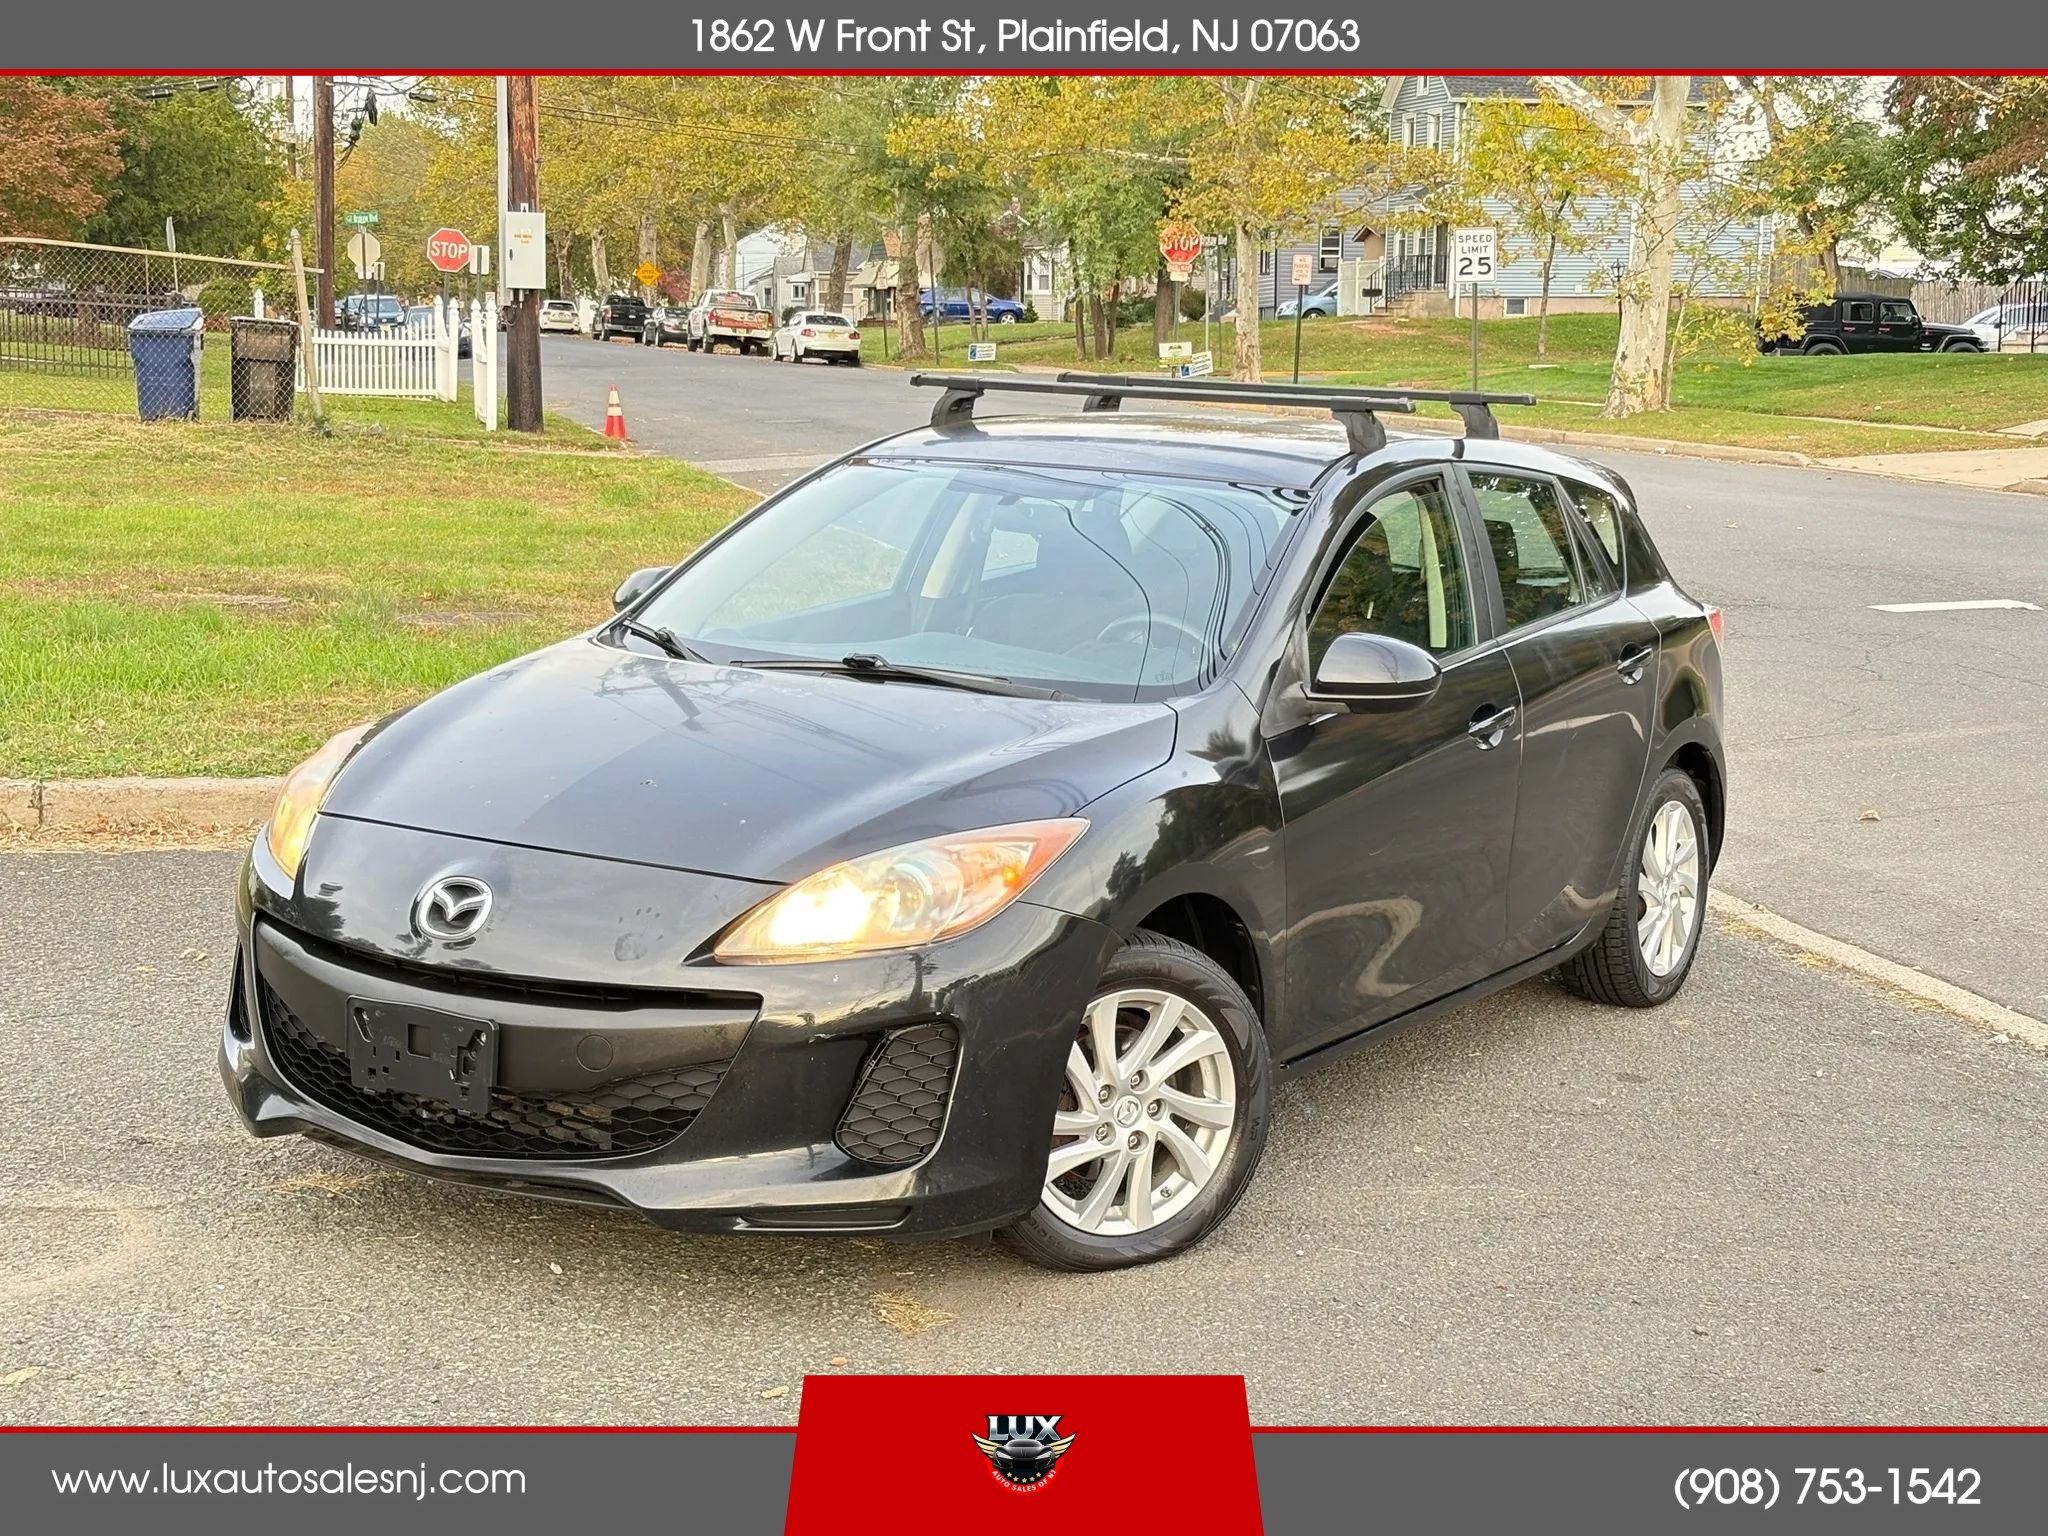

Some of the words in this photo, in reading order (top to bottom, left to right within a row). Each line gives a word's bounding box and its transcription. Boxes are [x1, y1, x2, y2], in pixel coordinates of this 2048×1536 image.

[1458, 234, 1493, 244] SPEED
[430, 240, 468, 260] STOP
[1461, 245, 1489, 255] LIMIT
[1459, 256, 1492, 276] 25
